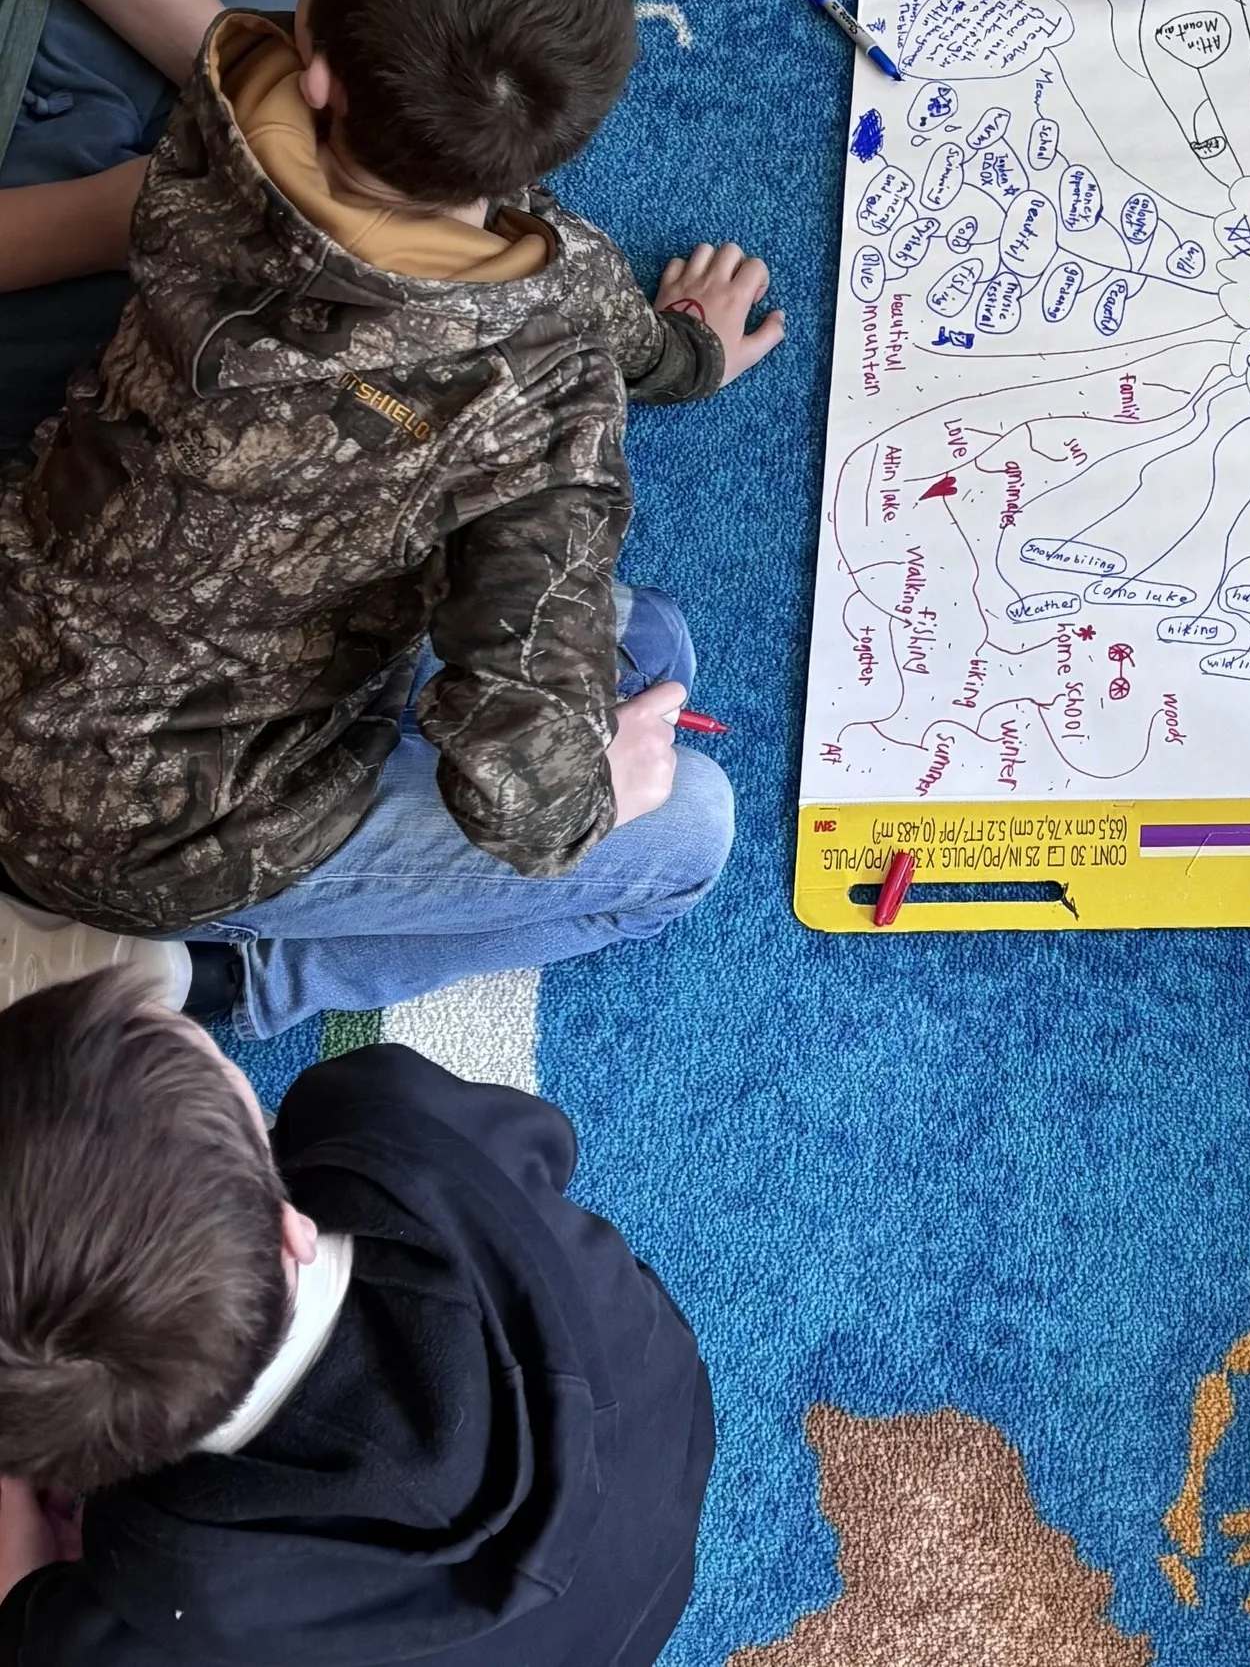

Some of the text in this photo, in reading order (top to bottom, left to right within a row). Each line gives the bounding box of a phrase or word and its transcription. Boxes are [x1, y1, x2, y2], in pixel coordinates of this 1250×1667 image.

[880, 489, 901, 523] lake
[814, 820, 837, 832] 3M
[897, 817, 935, 844] (0,483
[987, 820, 1006, 841] 5.2
[1010, 817, 1033, 842] cm)
[1037, 815, 1061, 840] 76,2
[1065, 820, 1072, 835] x
[1076, 820, 1095, 835] cm
[1099, 815, 1127, 841] (63,5
[926, 848, 935, 868] X
[939, 845, 1021, 871] IN/PO/PULG.
[1026, 846, 1040, 867] 25
[1071, 846, 1086, 866] 30
[1090, 845, 1127, 866] CONT.
